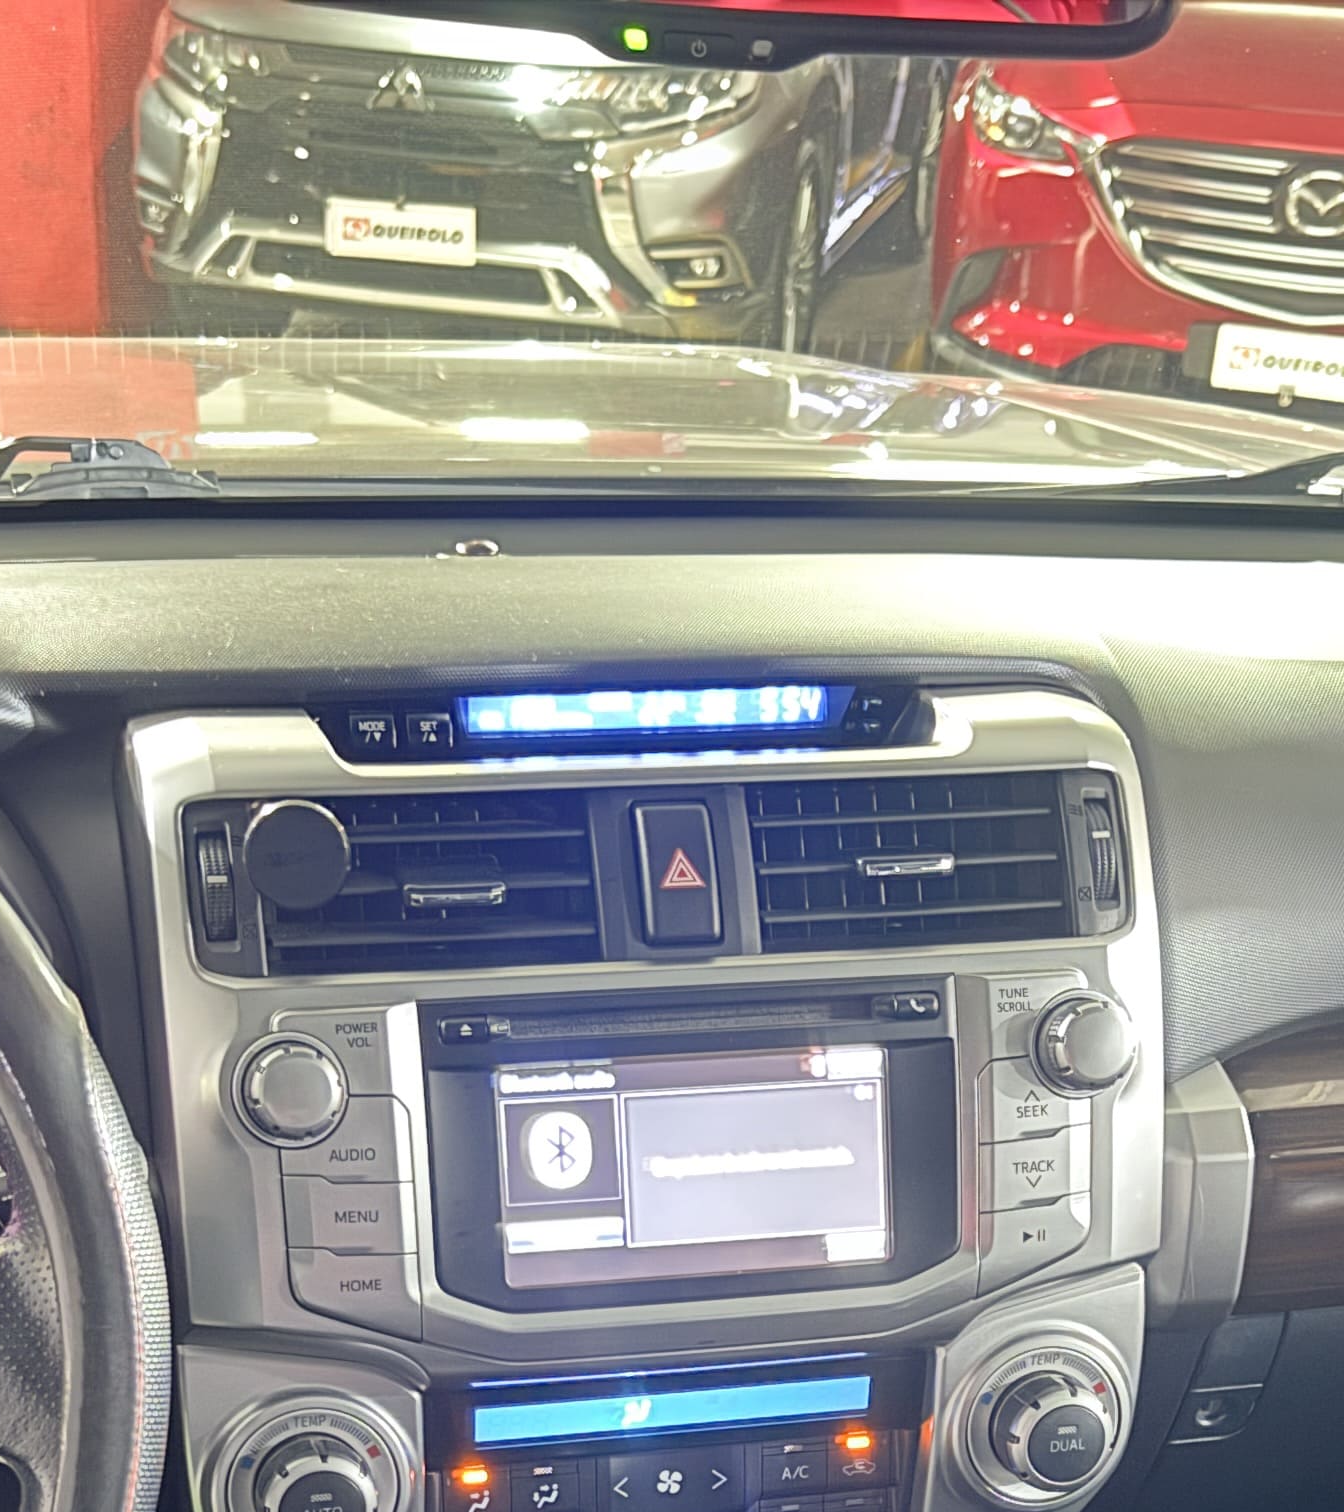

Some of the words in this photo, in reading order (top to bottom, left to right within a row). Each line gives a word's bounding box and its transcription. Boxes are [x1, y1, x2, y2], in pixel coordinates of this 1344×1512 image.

[358, 721, 387, 732] MODE
[419, 721, 438, 732] SET
[998, 987, 1029, 999] TUNE
[997, 1001, 1033, 1013] SCROLL
[336, 1022, 378, 1034] POWER
[347, 1036, 372, 1048] VOL
[1016, 1103, 1048, 1118] SEEK
[329, 1147, 376, 1163] AUDIO
[1012, 1159, 1056, 1174] TRACK
[334, 1210, 379, 1224] MENU
[339, 1279, 382, 1292] HOME
[1030, 1353, 1061, 1366] TEMP
[293, 1415, 327, 1429] TEMP
[1050, 1439, 1086, 1453] DUAL
[782, 1465, 809, 1481] A/C
